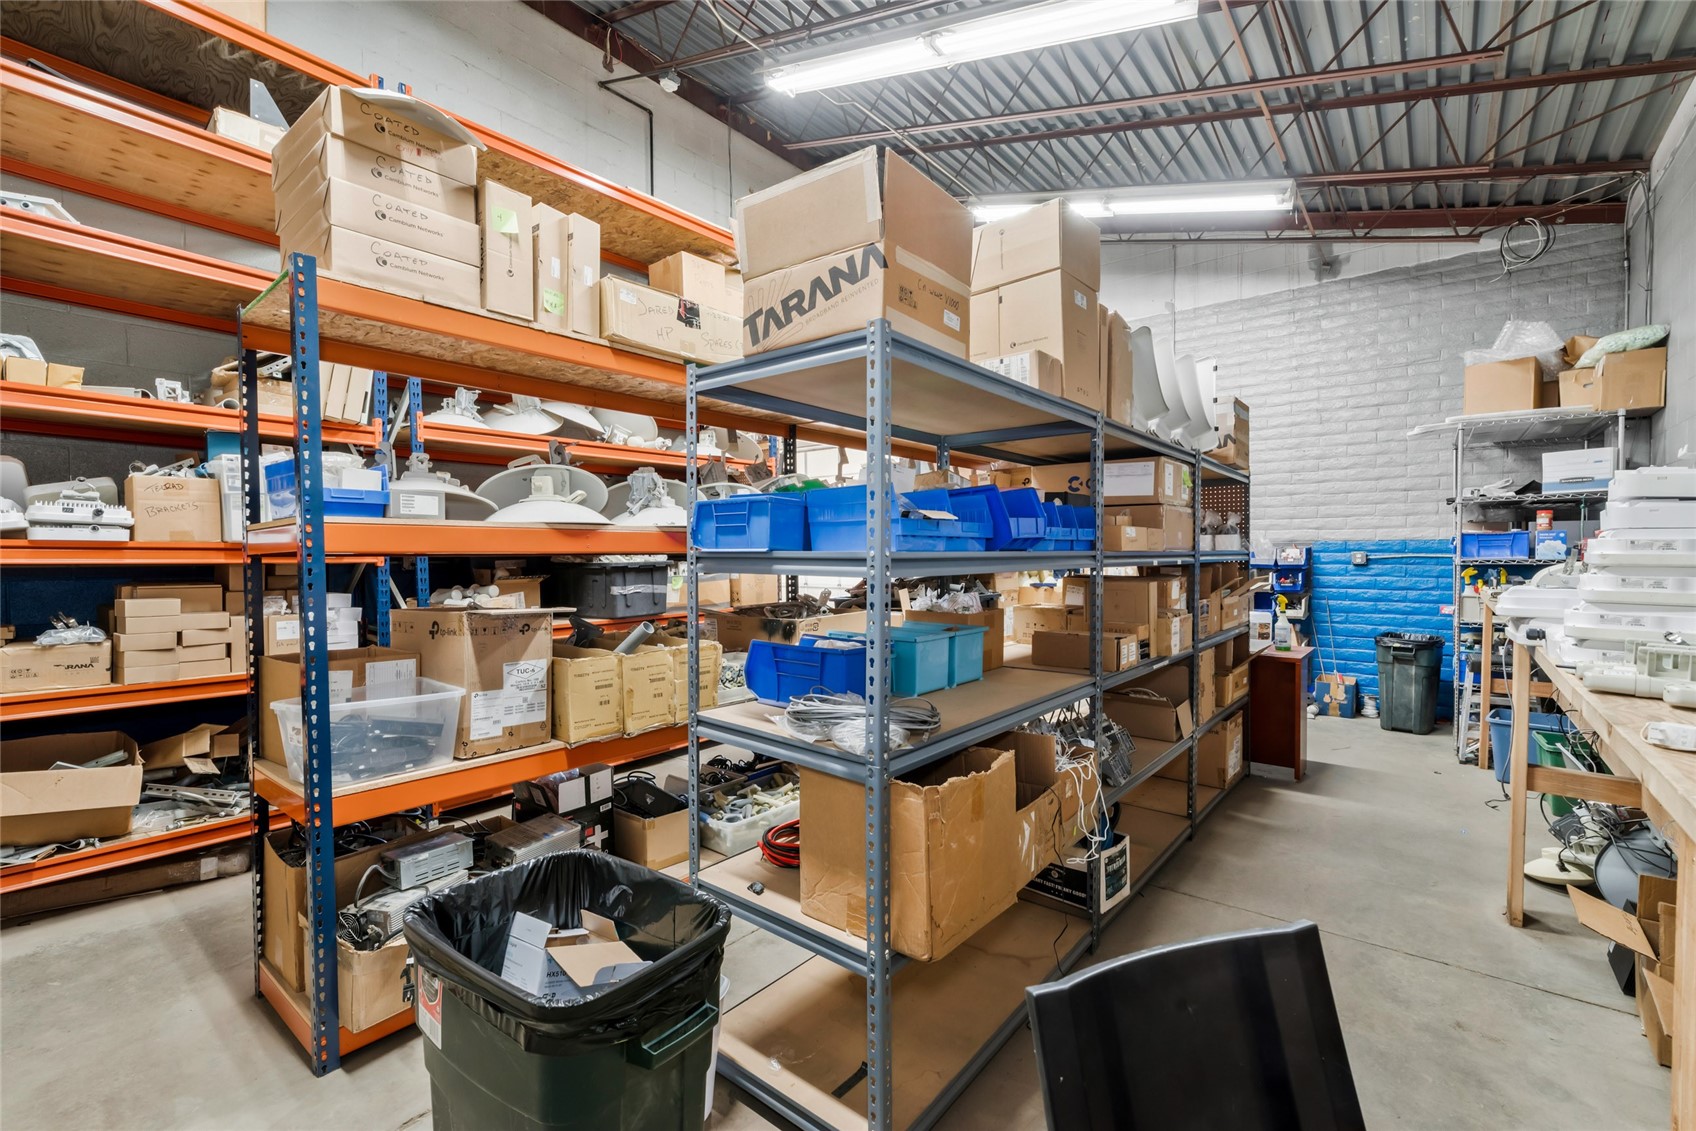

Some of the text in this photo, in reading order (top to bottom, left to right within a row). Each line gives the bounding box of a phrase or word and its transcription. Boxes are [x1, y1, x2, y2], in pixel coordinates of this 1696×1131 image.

[360, 102, 420, 136] COATED
[387, 130, 414, 144] Cambium
[375, 155, 432, 184] COATED
[384, 174, 439, 197] Cambium Networks
[372, 193, 429, 220] COATED
[388, 216, 444, 237] Cambium Networks
[370, 240, 428, 266] COATED
[389, 262, 445, 281] Cambium Networks
[743, 242, 889, 347] TARANA
[805, 278, 879, 325] BROADBAND REINVENTED
[638, 297, 674, 316] JARED
[656, 326, 674, 341] HP
[701, 331, 733, 351] SPARES
[144, 482, 184, 493] TELRAD
[144, 501, 199, 517] BRACKETS
[439, 627, 457, 637] tp-link
